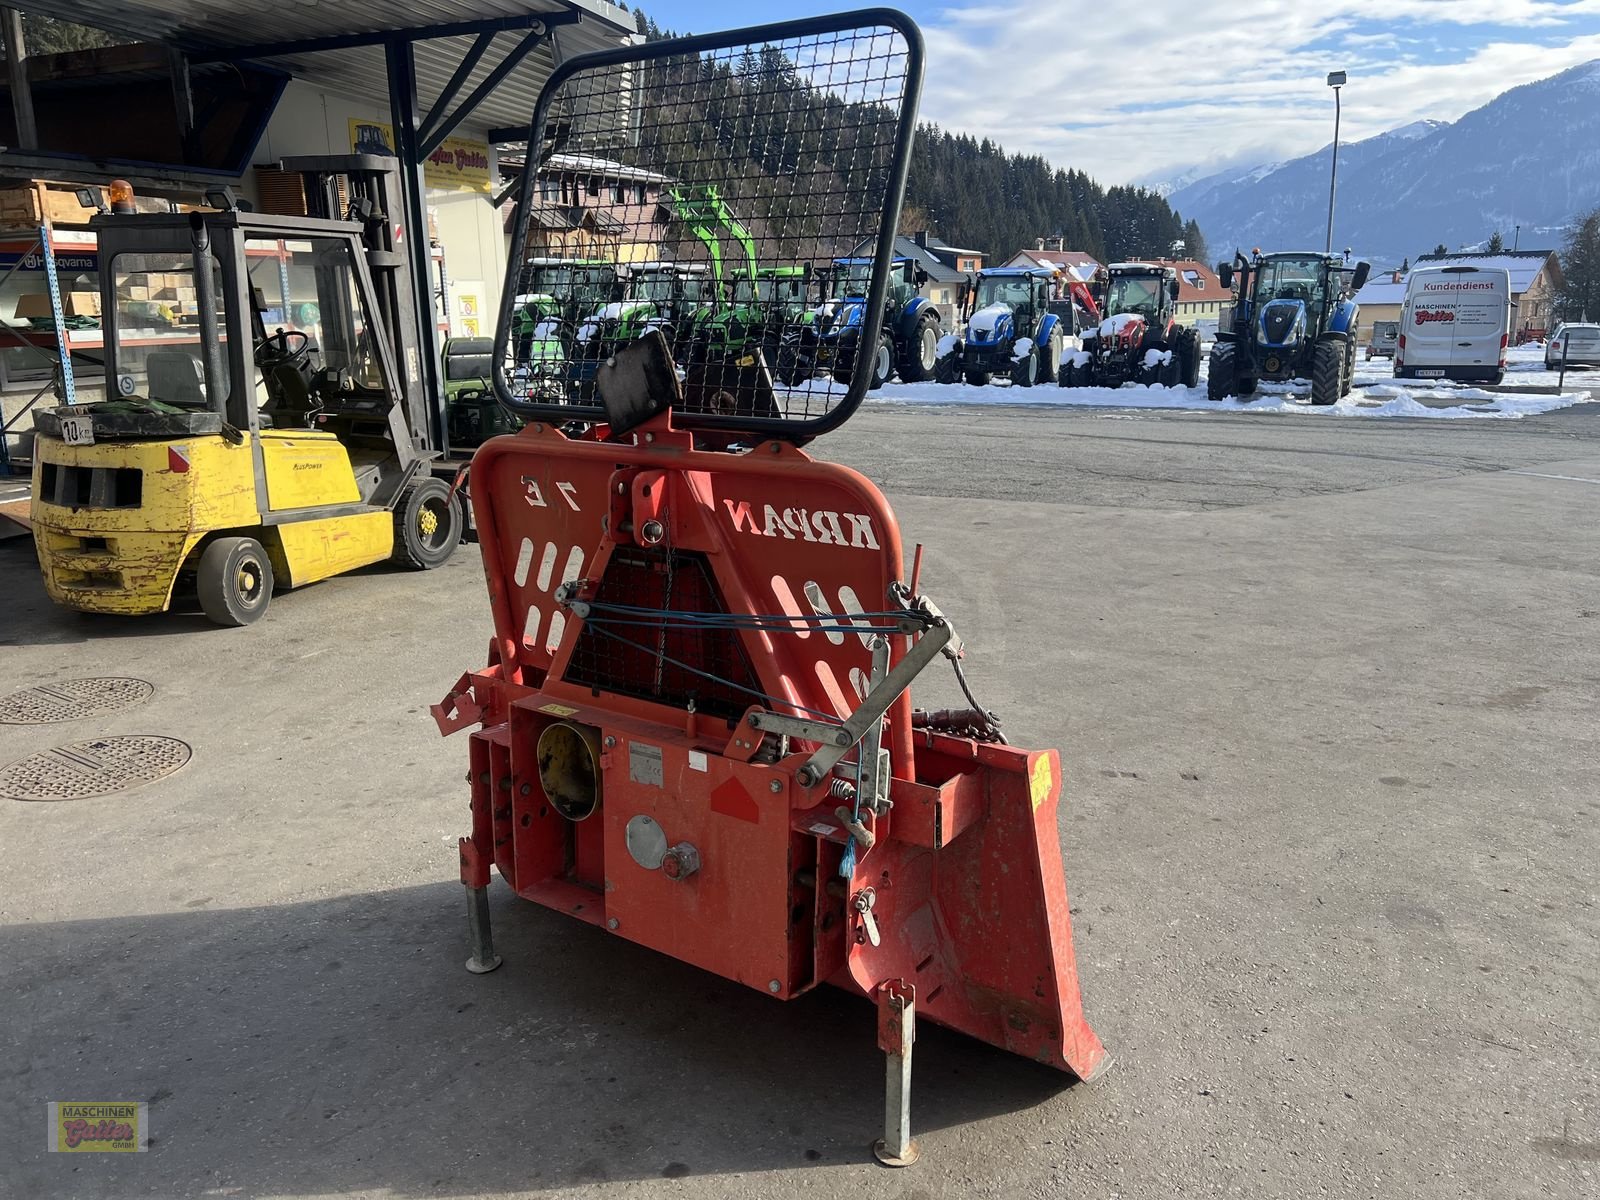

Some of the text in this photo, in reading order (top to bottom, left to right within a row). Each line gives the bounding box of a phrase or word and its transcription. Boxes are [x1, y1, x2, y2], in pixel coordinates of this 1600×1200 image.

[38, 256, 93, 268] Hsqvarna
[1424, 282, 1494, 291] Kundendienst
[64, 421, 79, 442] 10
